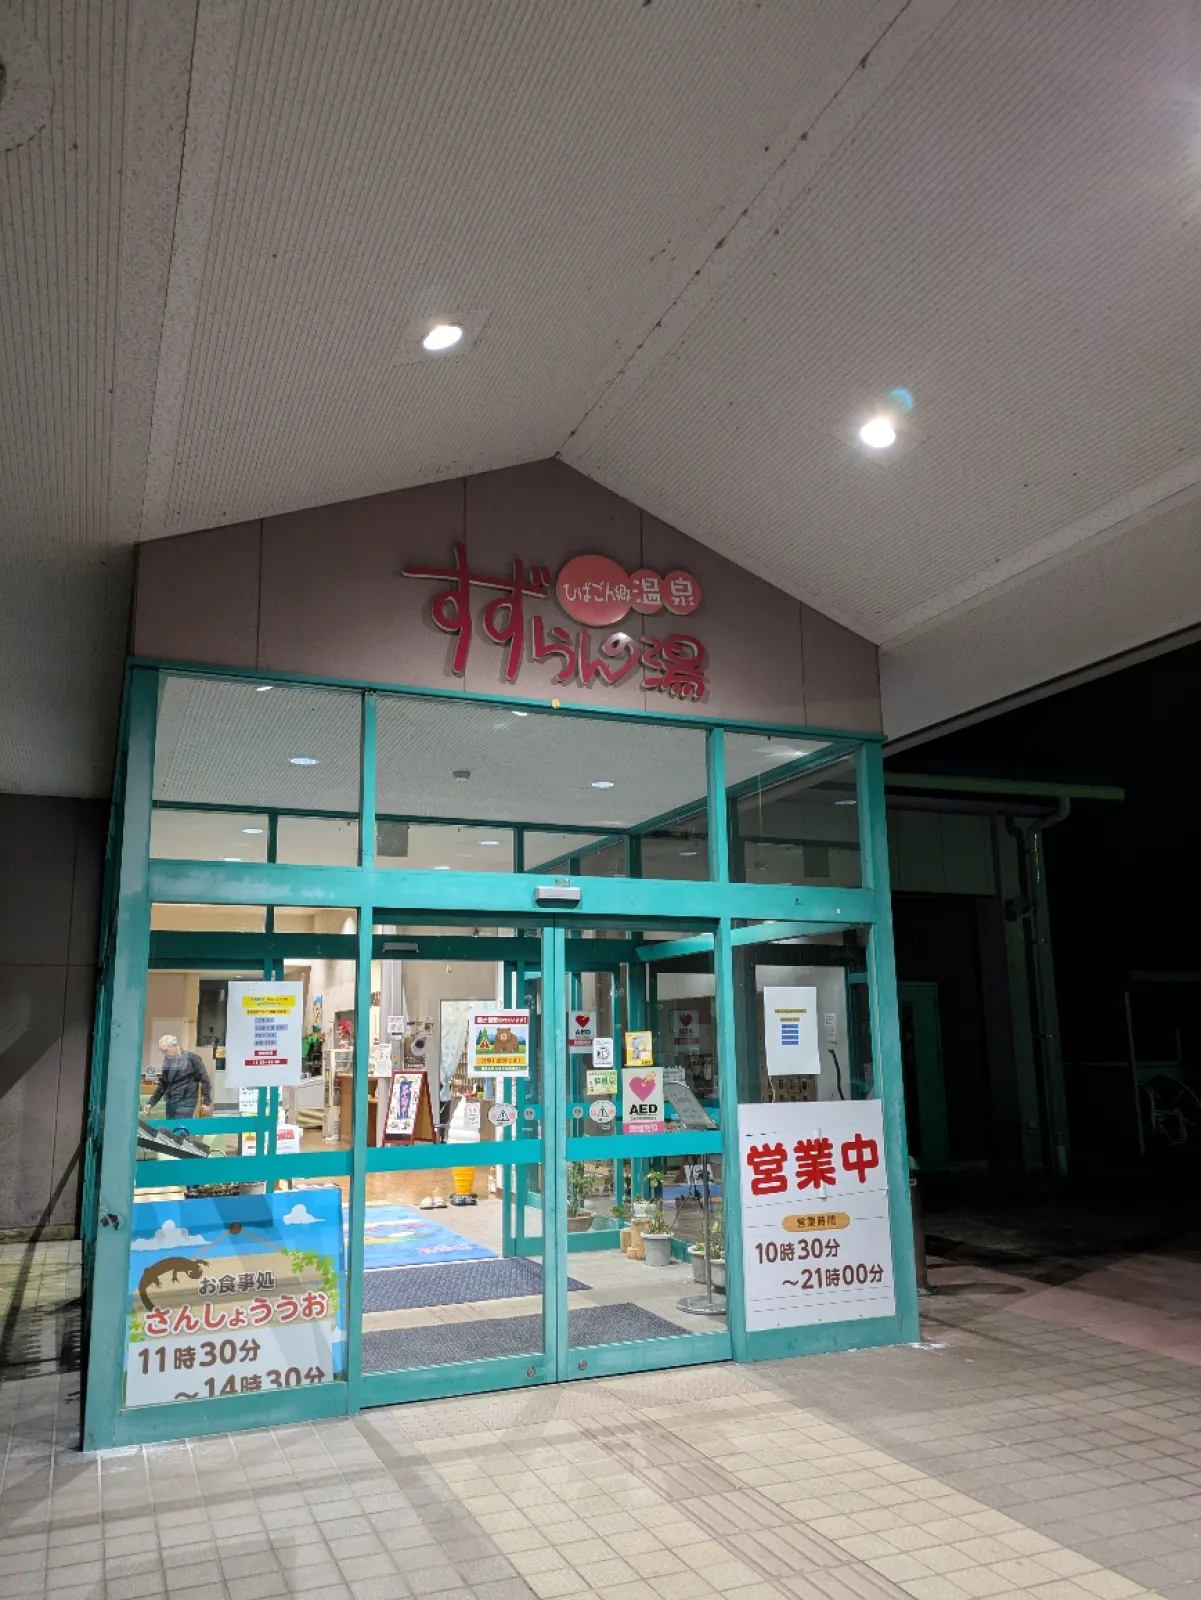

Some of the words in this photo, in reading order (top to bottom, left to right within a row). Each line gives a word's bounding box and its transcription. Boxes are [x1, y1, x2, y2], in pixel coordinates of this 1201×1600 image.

[402, 542, 706, 699] すずらんの湯
[629, 1104, 658, 1114] AED
[747, 1133, 879, 1195] 営業中
[755, 1238, 841, 1264] 10時30分
[199, 1272, 275, 1294] お食事処
[145, 1293, 327, 1335] さんしょううお
[138, 1339, 261, 1374] 11時30分
